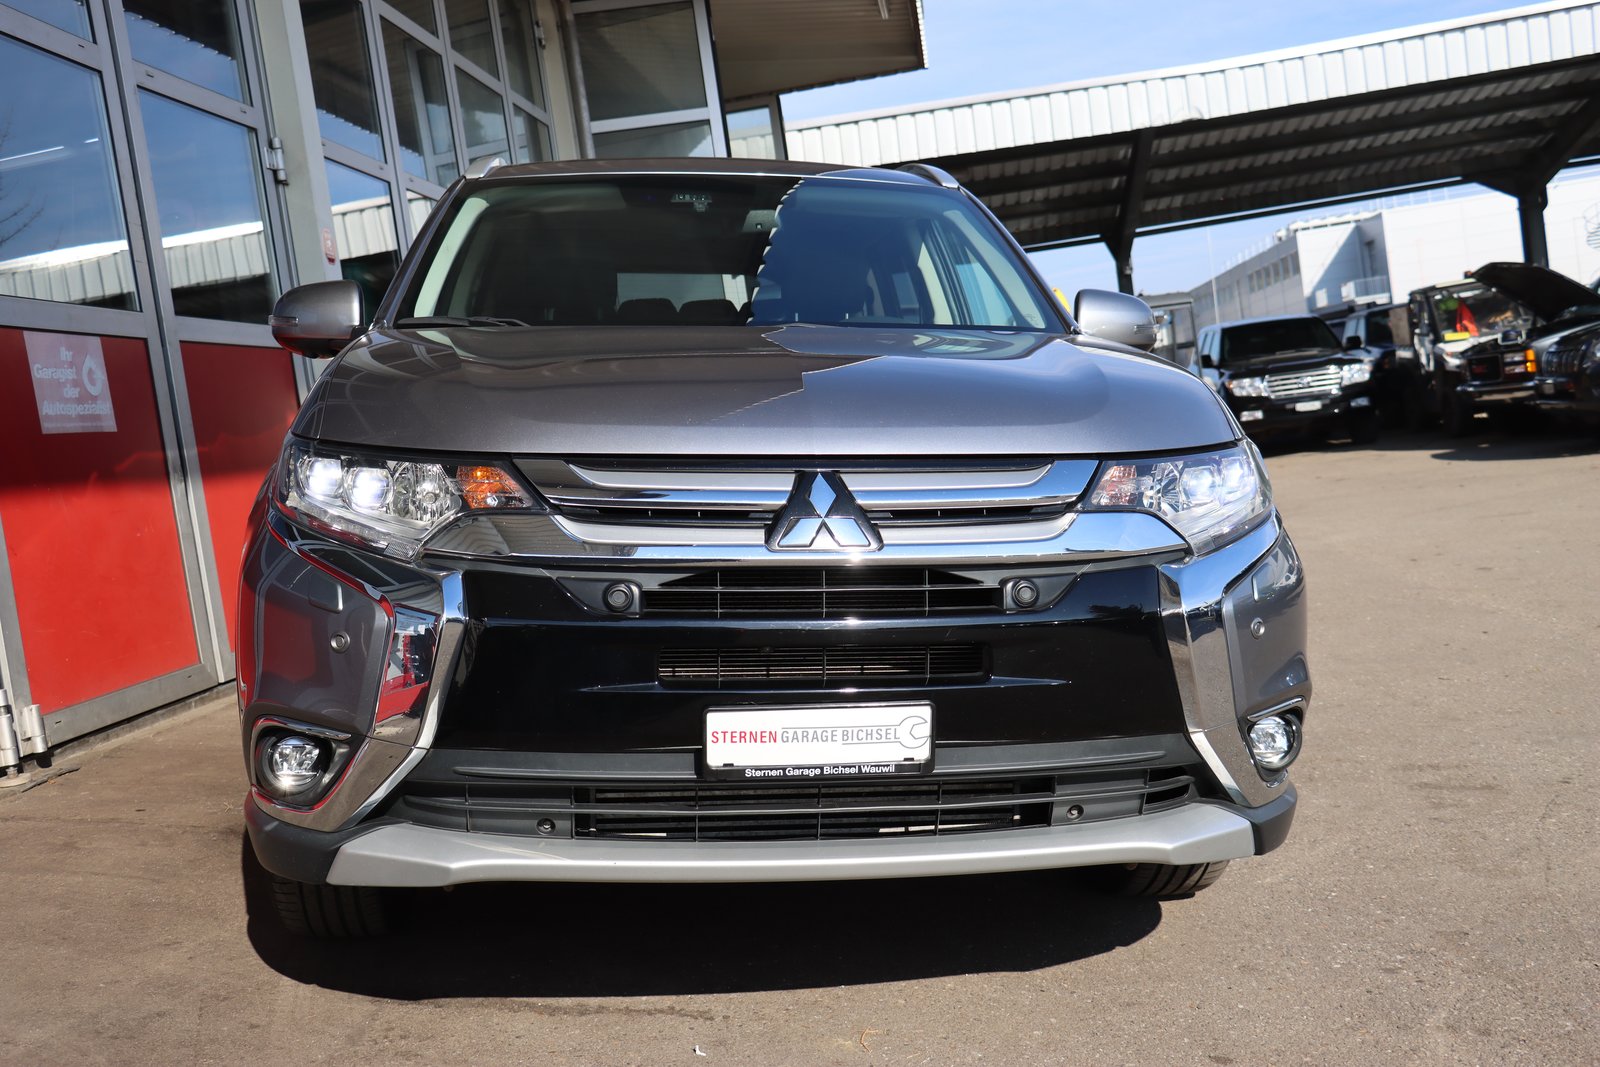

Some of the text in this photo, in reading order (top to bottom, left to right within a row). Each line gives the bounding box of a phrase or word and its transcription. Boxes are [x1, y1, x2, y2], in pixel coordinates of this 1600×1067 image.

[60, 346, 73, 361] Ihr
[33, 363, 77, 382] Garagist
[63, 384, 80, 398] der
[711, 728, 901, 744] STERNEN GARAGE BICHSEL
[745, 764, 895, 777] Sternen Garage Bichsel Wauwil
